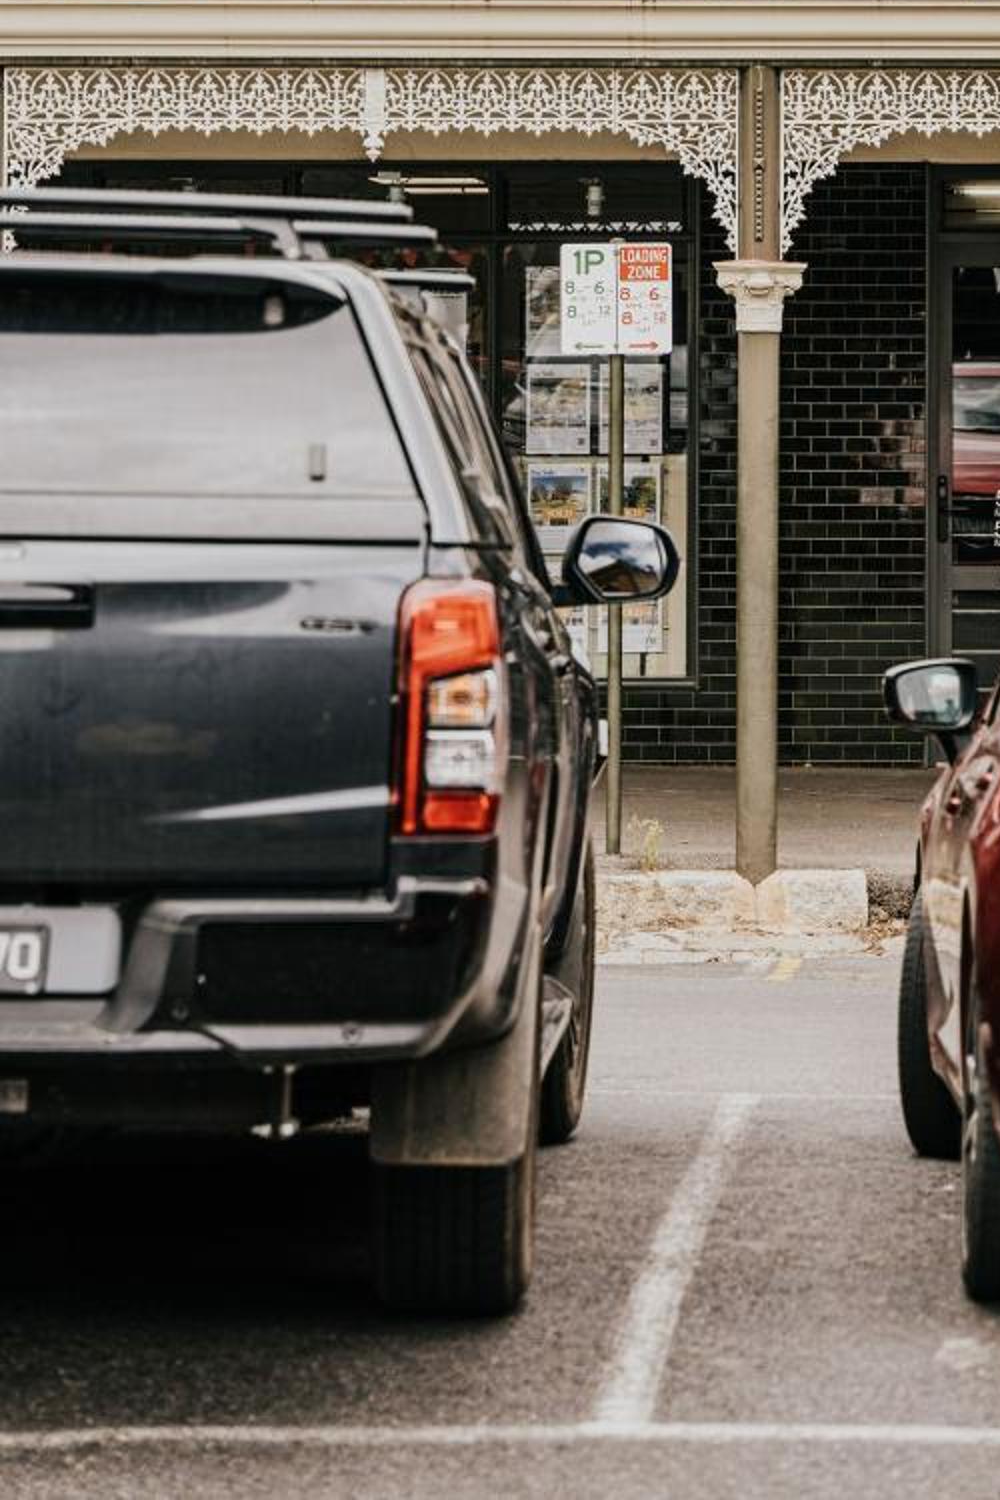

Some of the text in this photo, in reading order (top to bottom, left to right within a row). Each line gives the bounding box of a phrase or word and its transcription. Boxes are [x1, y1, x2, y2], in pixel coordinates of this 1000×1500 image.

[621, 248, 668, 262] LOADING
[573, 250, 605, 275] 1P
[627, 265, 661, 279] ZONE
